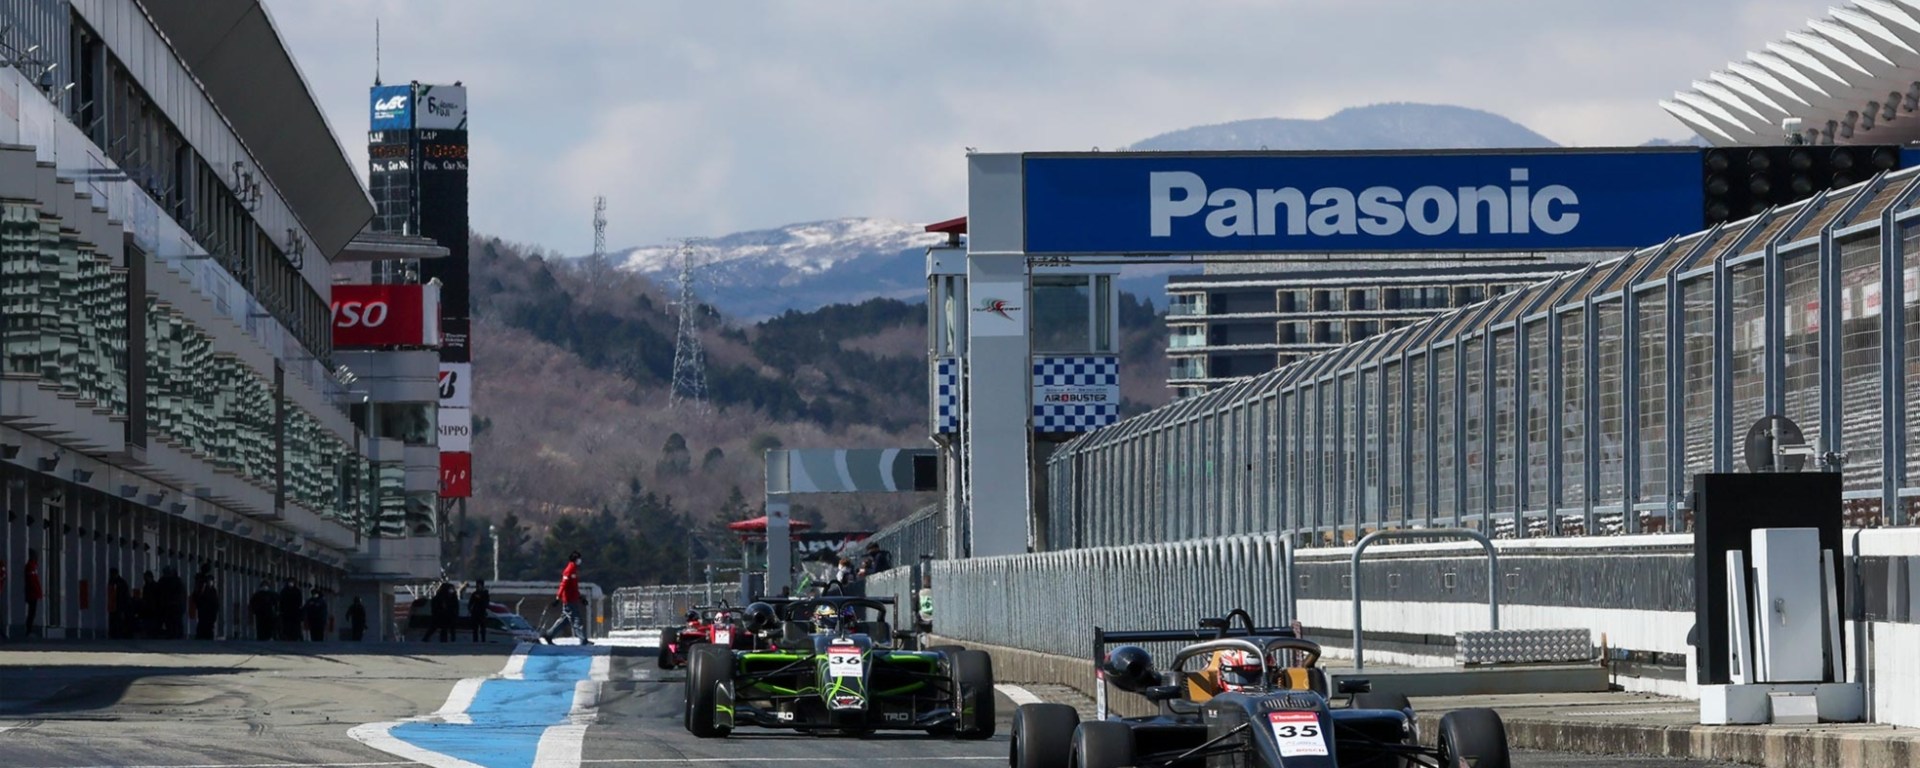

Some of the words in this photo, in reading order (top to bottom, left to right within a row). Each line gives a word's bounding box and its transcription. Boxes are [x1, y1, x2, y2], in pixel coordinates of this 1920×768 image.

[427, 96, 436, 114] 6
[370, 131, 384, 143] LAP
[420, 130, 437, 140] LAP
[388, 160, 398, 171] Car
[443, 160, 456, 170] Car
[1149, 167, 1581, 238] Panasonic
[830, 655, 861, 665] 36
[883, 712, 909, 721] TRD
[1278, 725, 1318, 738] 35
